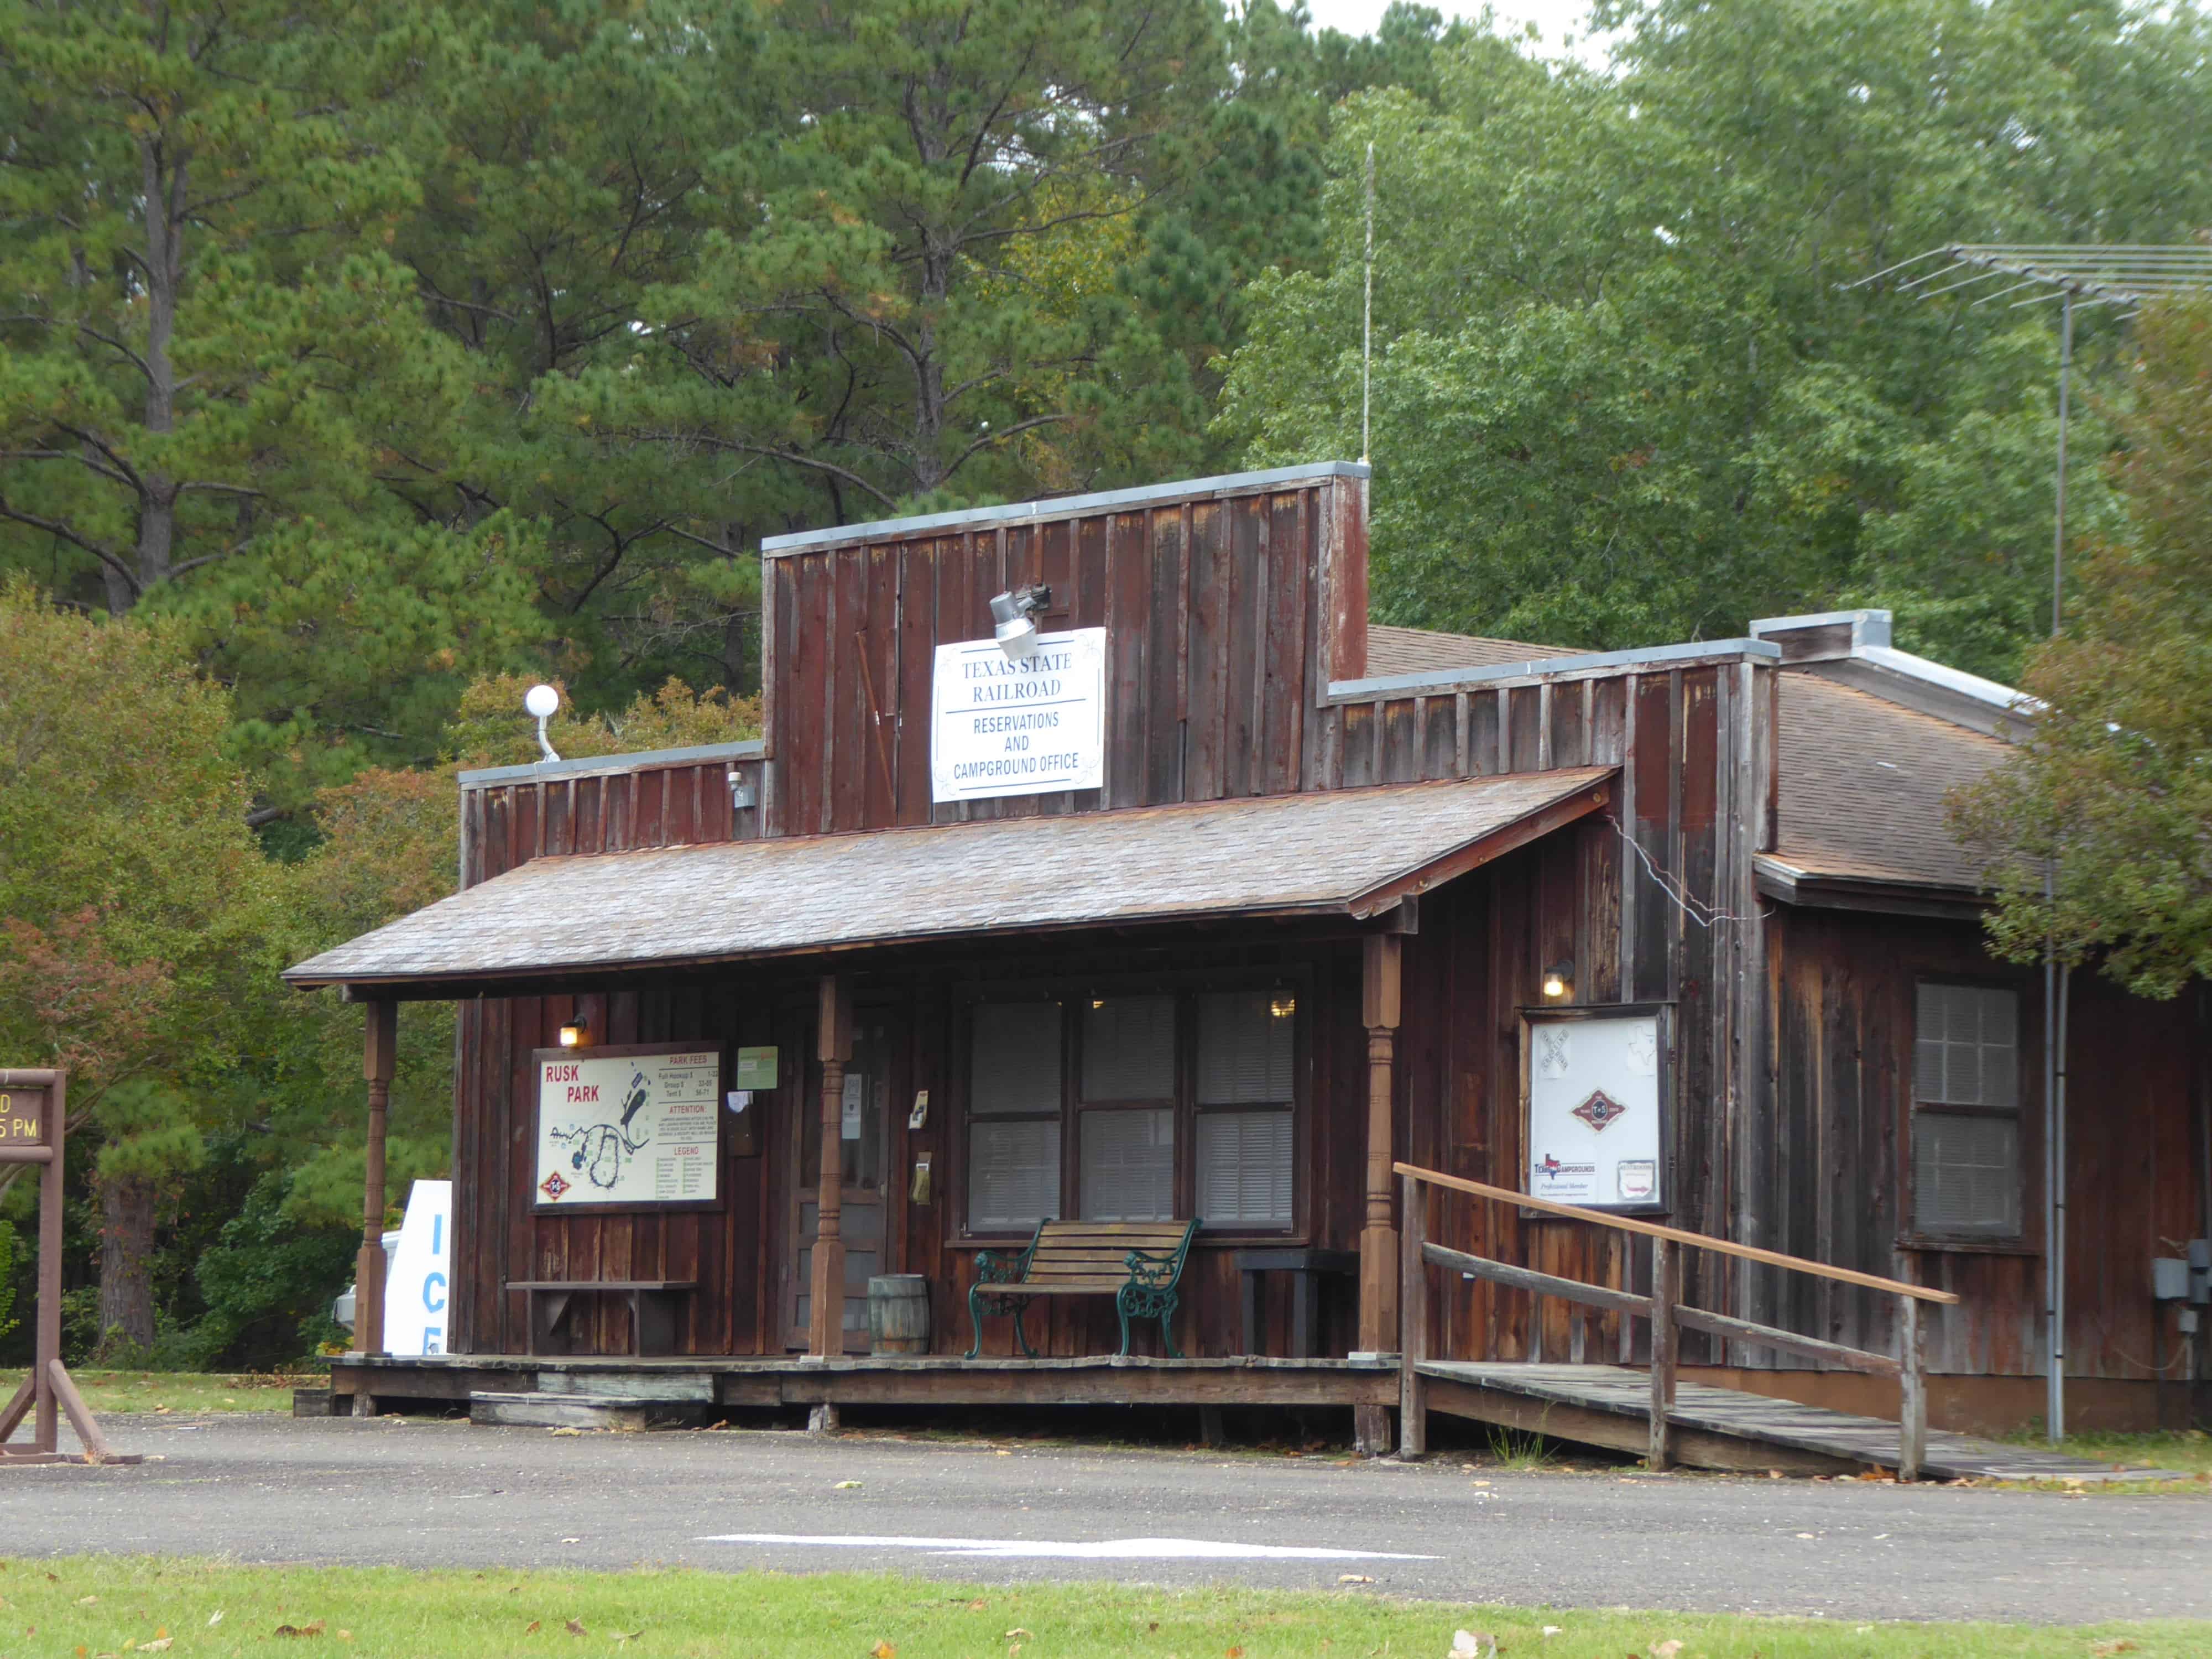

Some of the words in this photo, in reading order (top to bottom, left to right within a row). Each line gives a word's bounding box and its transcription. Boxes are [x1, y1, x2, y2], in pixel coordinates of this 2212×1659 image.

[962, 660, 1016, 679] TEXAS
[1020, 653, 1072, 674] STATE
[973, 679, 1061, 703] RAILROAD
[974, 711, 1059, 734] RESERVATIONS
[1004, 735, 1029, 752] AND
[954, 758, 1036, 780] CAMPGROUND
[1040, 753, 1079, 771] OFFICE
[670, 1055, 687, 1065] PARK
[690, 1055, 707, 1063] FEES
[546, 1065, 579, 1082] RUSK
[567, 1084, 599, 1103] PARK
[13, 1119, 36, 1137] PM
[674, 1146, 699, 1155] LEGEND
